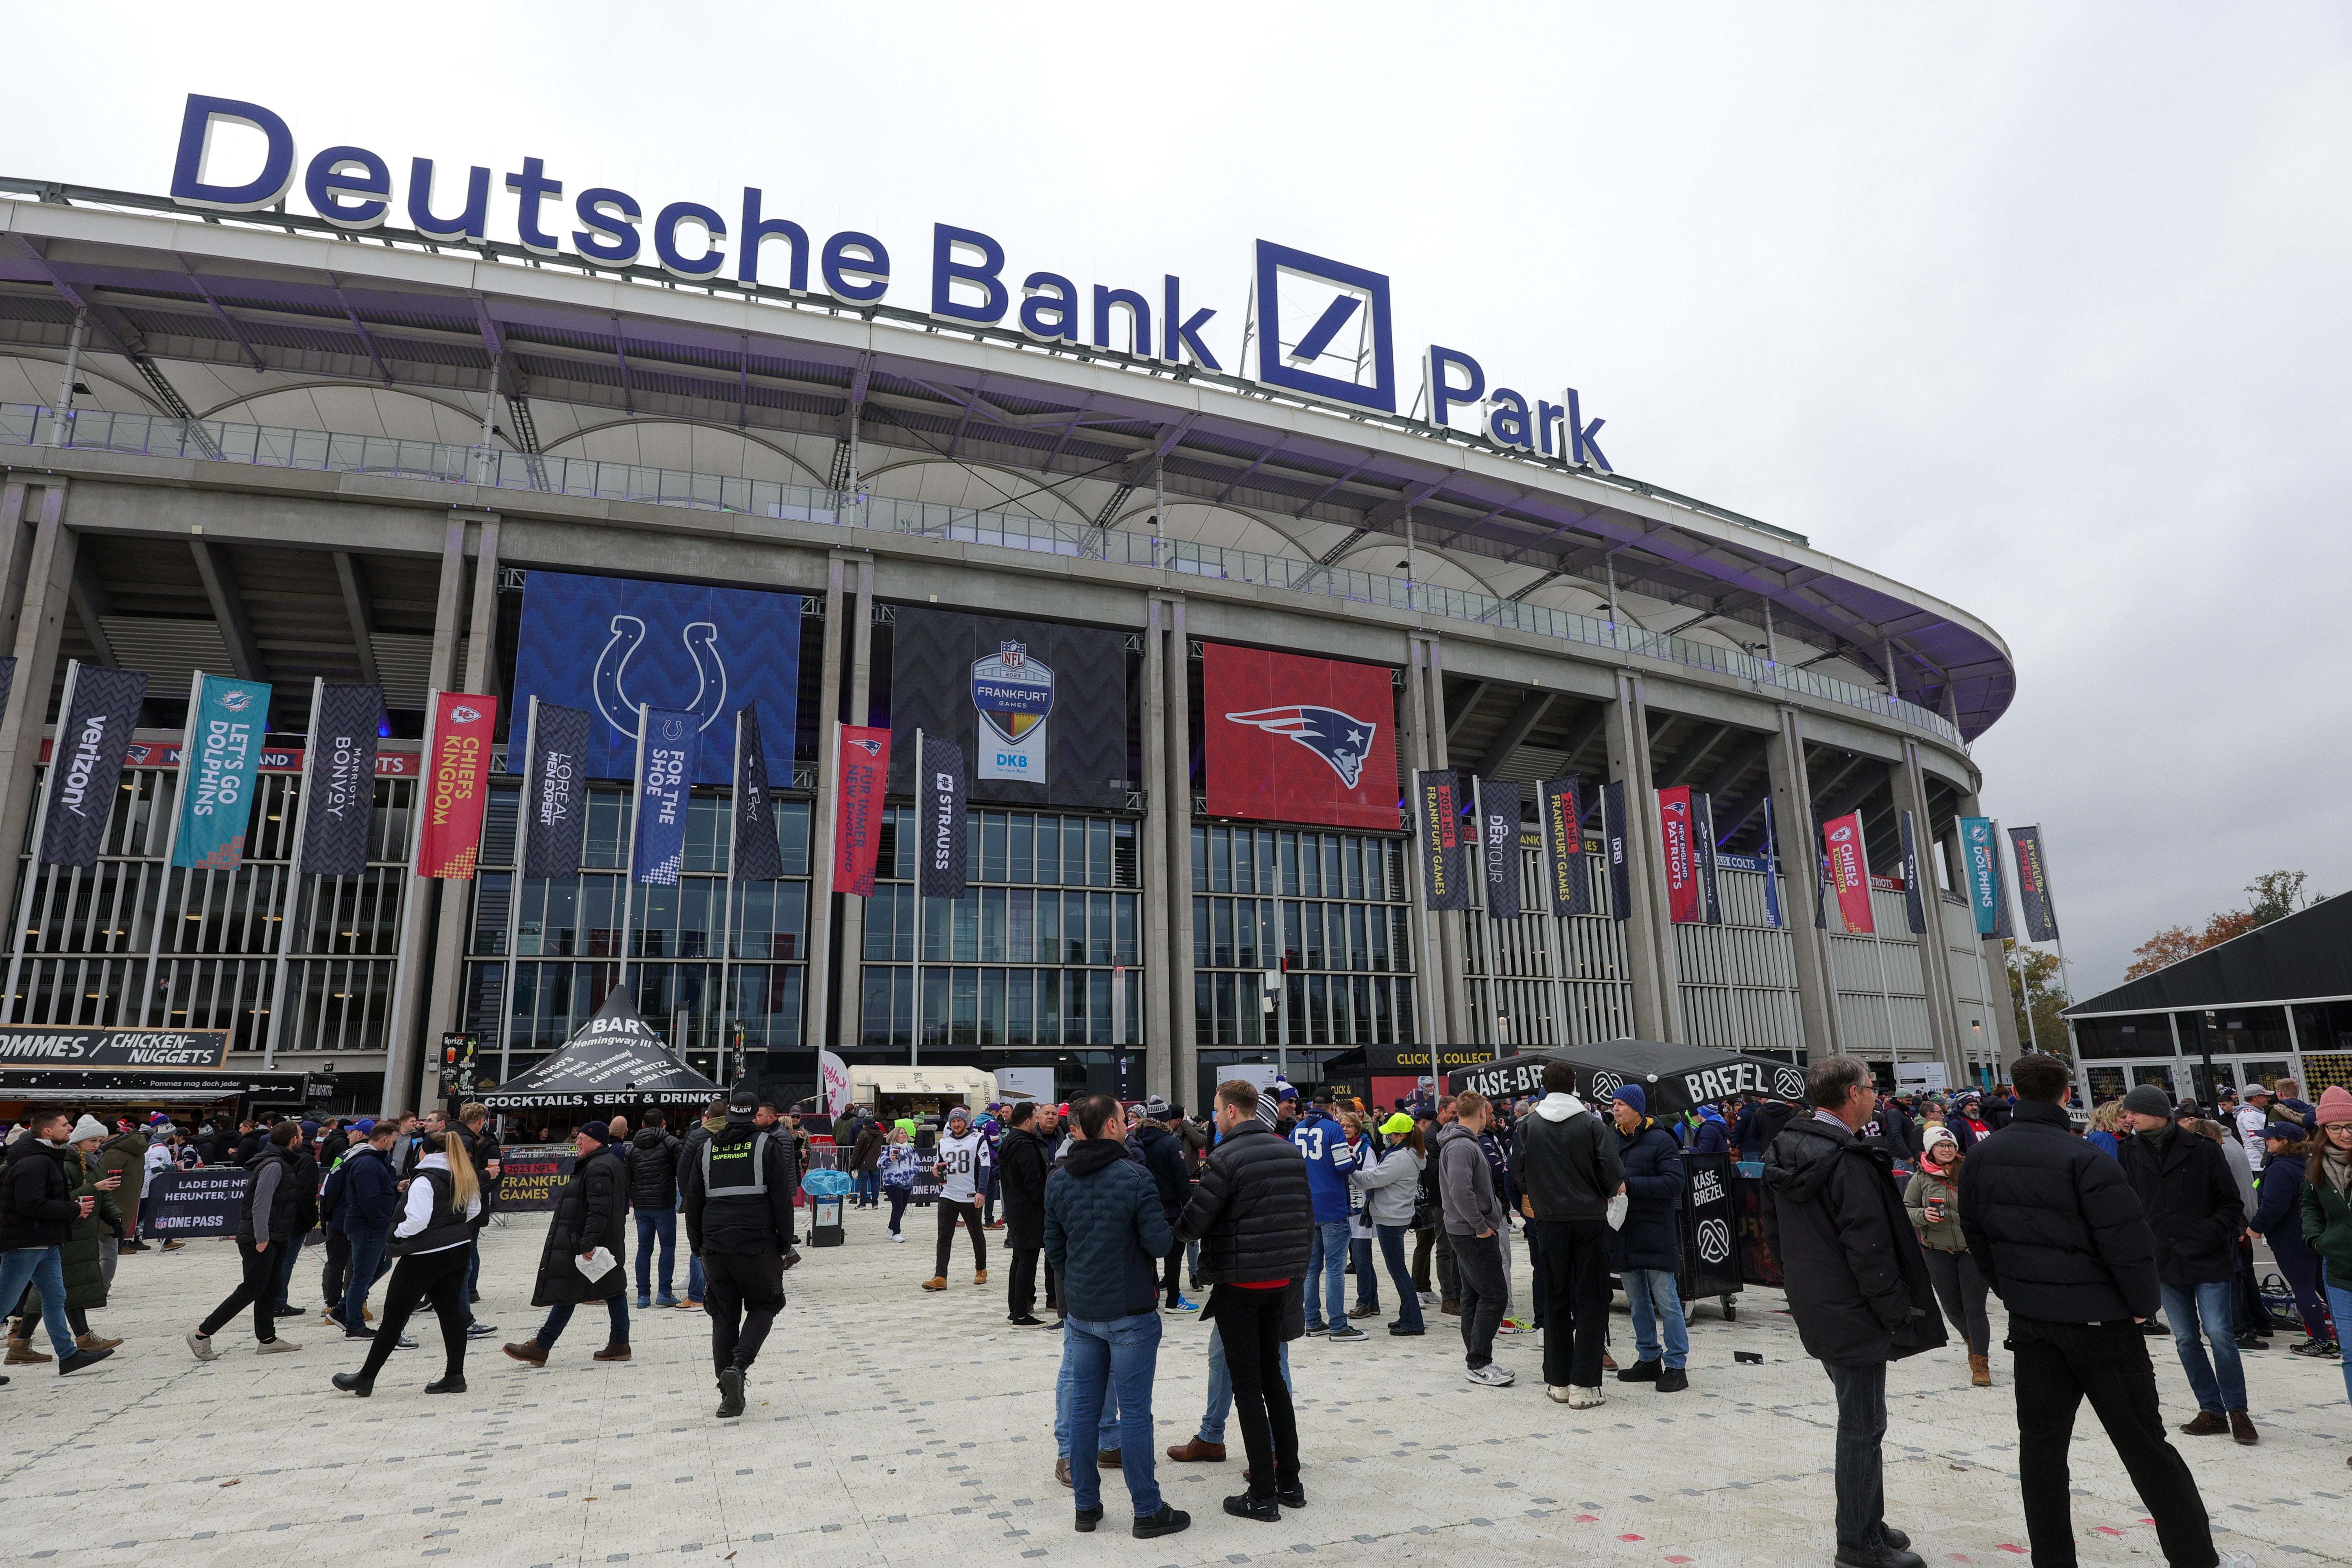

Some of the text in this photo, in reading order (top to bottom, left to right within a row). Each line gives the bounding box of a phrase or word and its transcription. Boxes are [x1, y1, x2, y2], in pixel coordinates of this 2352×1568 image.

[170, 93, 1613, 475] Deutsche Bank Park
[1004, 652, 1023, 666] NFL
[978, 686, 1048, 702] FRANKFURT
[61, 716, 107, 804] verizon
[194, 720, 229, 815] DOLPHINS
[218, 723, 250, 804] LET'S GO
[455, 737, 480, 799] CHIEFS
[646, 749, 668, 797] SHOE
[996, 753, 1027, 767] DKB
[327, 737, 351, 817] BONVOY
[348, 748, 362, 806] MARRIOTT
[432, 735, 462, 825] KINGDOM
[540, 751, 558, 826] MEN EXPERT
[552, 753, 572, 826] L'ORÉAL
[658, 750, 685, 825] FOR THE
[845, 764, 858, 873] NEW ENGLAND
[853, 766, 876, 848] FÜR IMMER
[1440, 791, 1453, 843] 2023 NFL
[935, 794, 952, 870] STRAUSS
[1563, 799, 1577, 848] 2023 NFL
[1427, 786, 1445, 895] FRANKFURT GAMES
[1489, 815, 1503, 882] DERTOUR
[1551, 794, 1570, 901] FRANKFURT GAMES
[1613, 841, 1621, 861] DB
[1667, 821, 1682, 890] PATRIOTS
[1731, 857, 1756, 869] COLTS
[1984, 849, 1992, 869] MIAMI
[1973, 846, 1993, 907] DOLPHINS
[591, 1017, 640, 1034] BAR
[111, 1033, 196, 1049] CHICKEN-
[444, 1037, 464, 1046] Sprizz
[571, 1036, 638, 1049] Hemingway
[640, 1039, 652, 1048] III
[127, 1049, 214, 1064] NUGGETS
[459, 1060, 475, 1070] Hugos
[573, 1049, 633, 1079] Frische Zubereitung!
[589, 1057, 645, 1084] CAIPIRINHA
[629, 1060, 671, 1076] SPRITZZ
[1397, 1053, 1430, 1065] CLICK
[1444, 1053, 1492, 1064] COLLECT
[528, 1080, 544, 1089] Sex
[553, 1070, 566, 1079] the
[565, 1060, 588, 1074] Beach
[633, 1067, 683, 1086] CUBA Libre
[1685, 1063, 1769, 1103] BREZEL
[484, 1092, 722, 1108] COCKTAILS, SEKT & DRINKS
[1345, 1085, 1351, 1094] &
[712, 1152, 748, 1160] SUPERVISOR
[1294, 1128, 1323, 1160] 53
[946, 1149, 971, 1175] 28
[178, 1180, 207, 1189] LADE
[210, 1180, 229, 1188] DIE
[1693, 1169, 1719, 1190] KÄSE-
[165, 1191, 227, 1201] HERUNTER,
[499, 1188, 549, 1200] GAMES
[1693, 1183, 1725, 1207] BREZEL
[167, 1215, 223, 1228] ONE PASS
